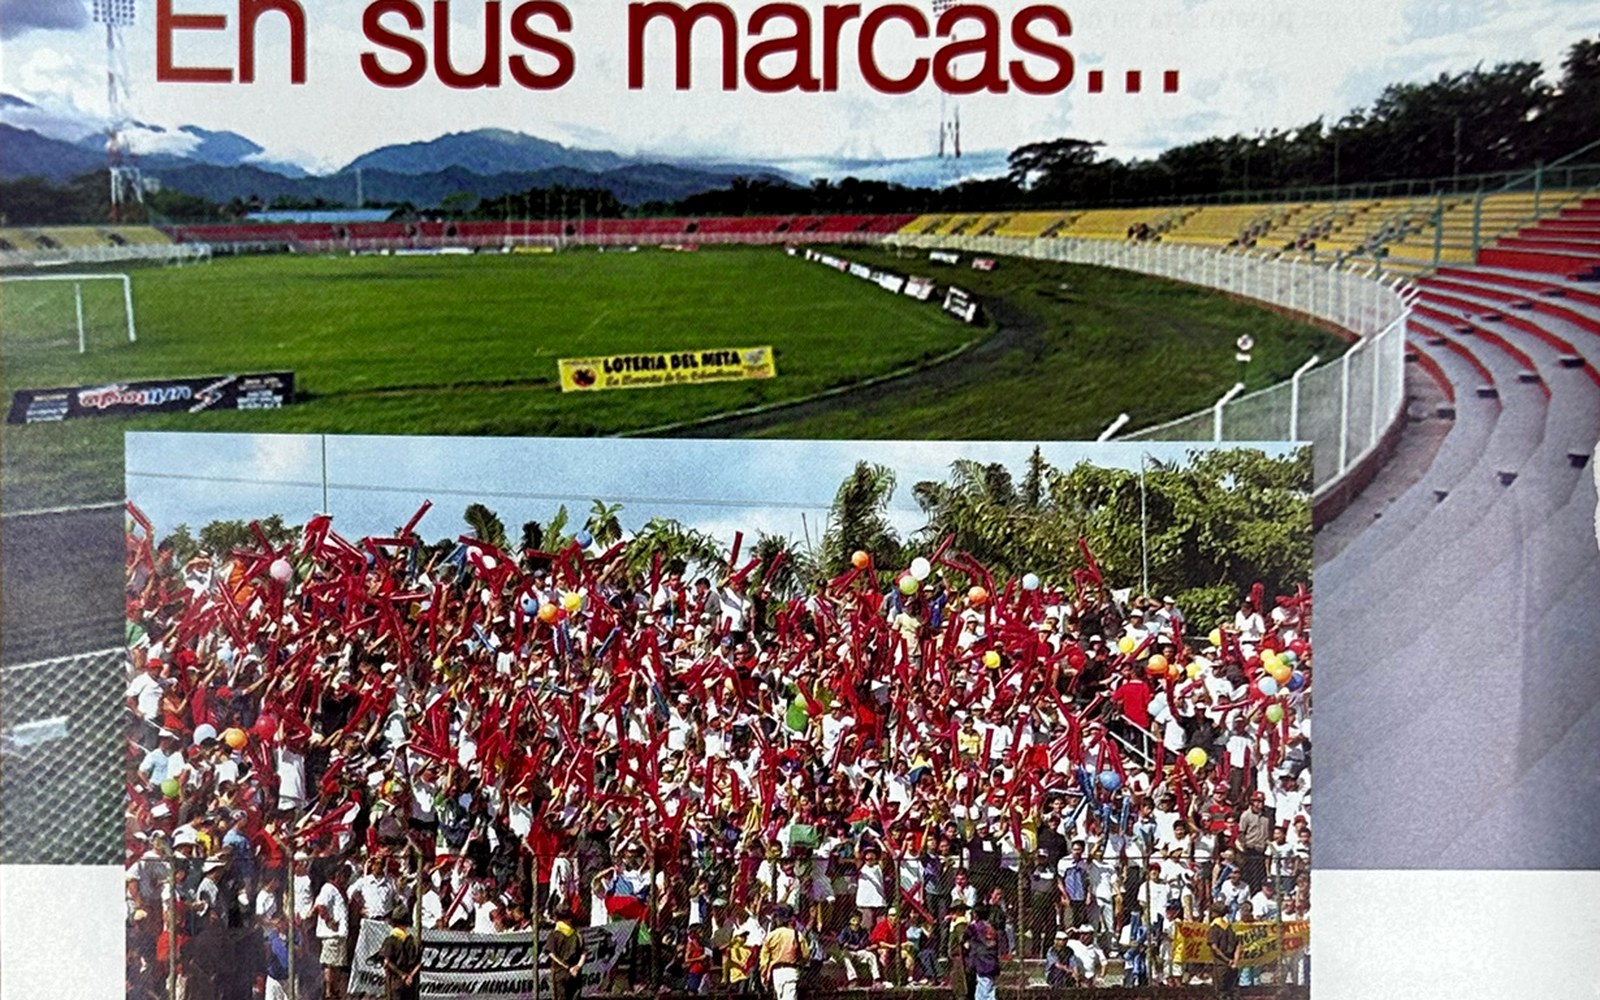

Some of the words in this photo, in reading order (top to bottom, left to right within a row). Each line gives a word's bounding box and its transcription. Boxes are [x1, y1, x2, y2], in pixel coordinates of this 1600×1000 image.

[155, 0, 306, 84] En
[361, 0, 574, 89] sus
[628, 1, 1180, 95] marcas...
[603, 355, 667, 374] LOTERIA
[671, 353, 699, 369] DEL
[701, 351, 742, 367] META
